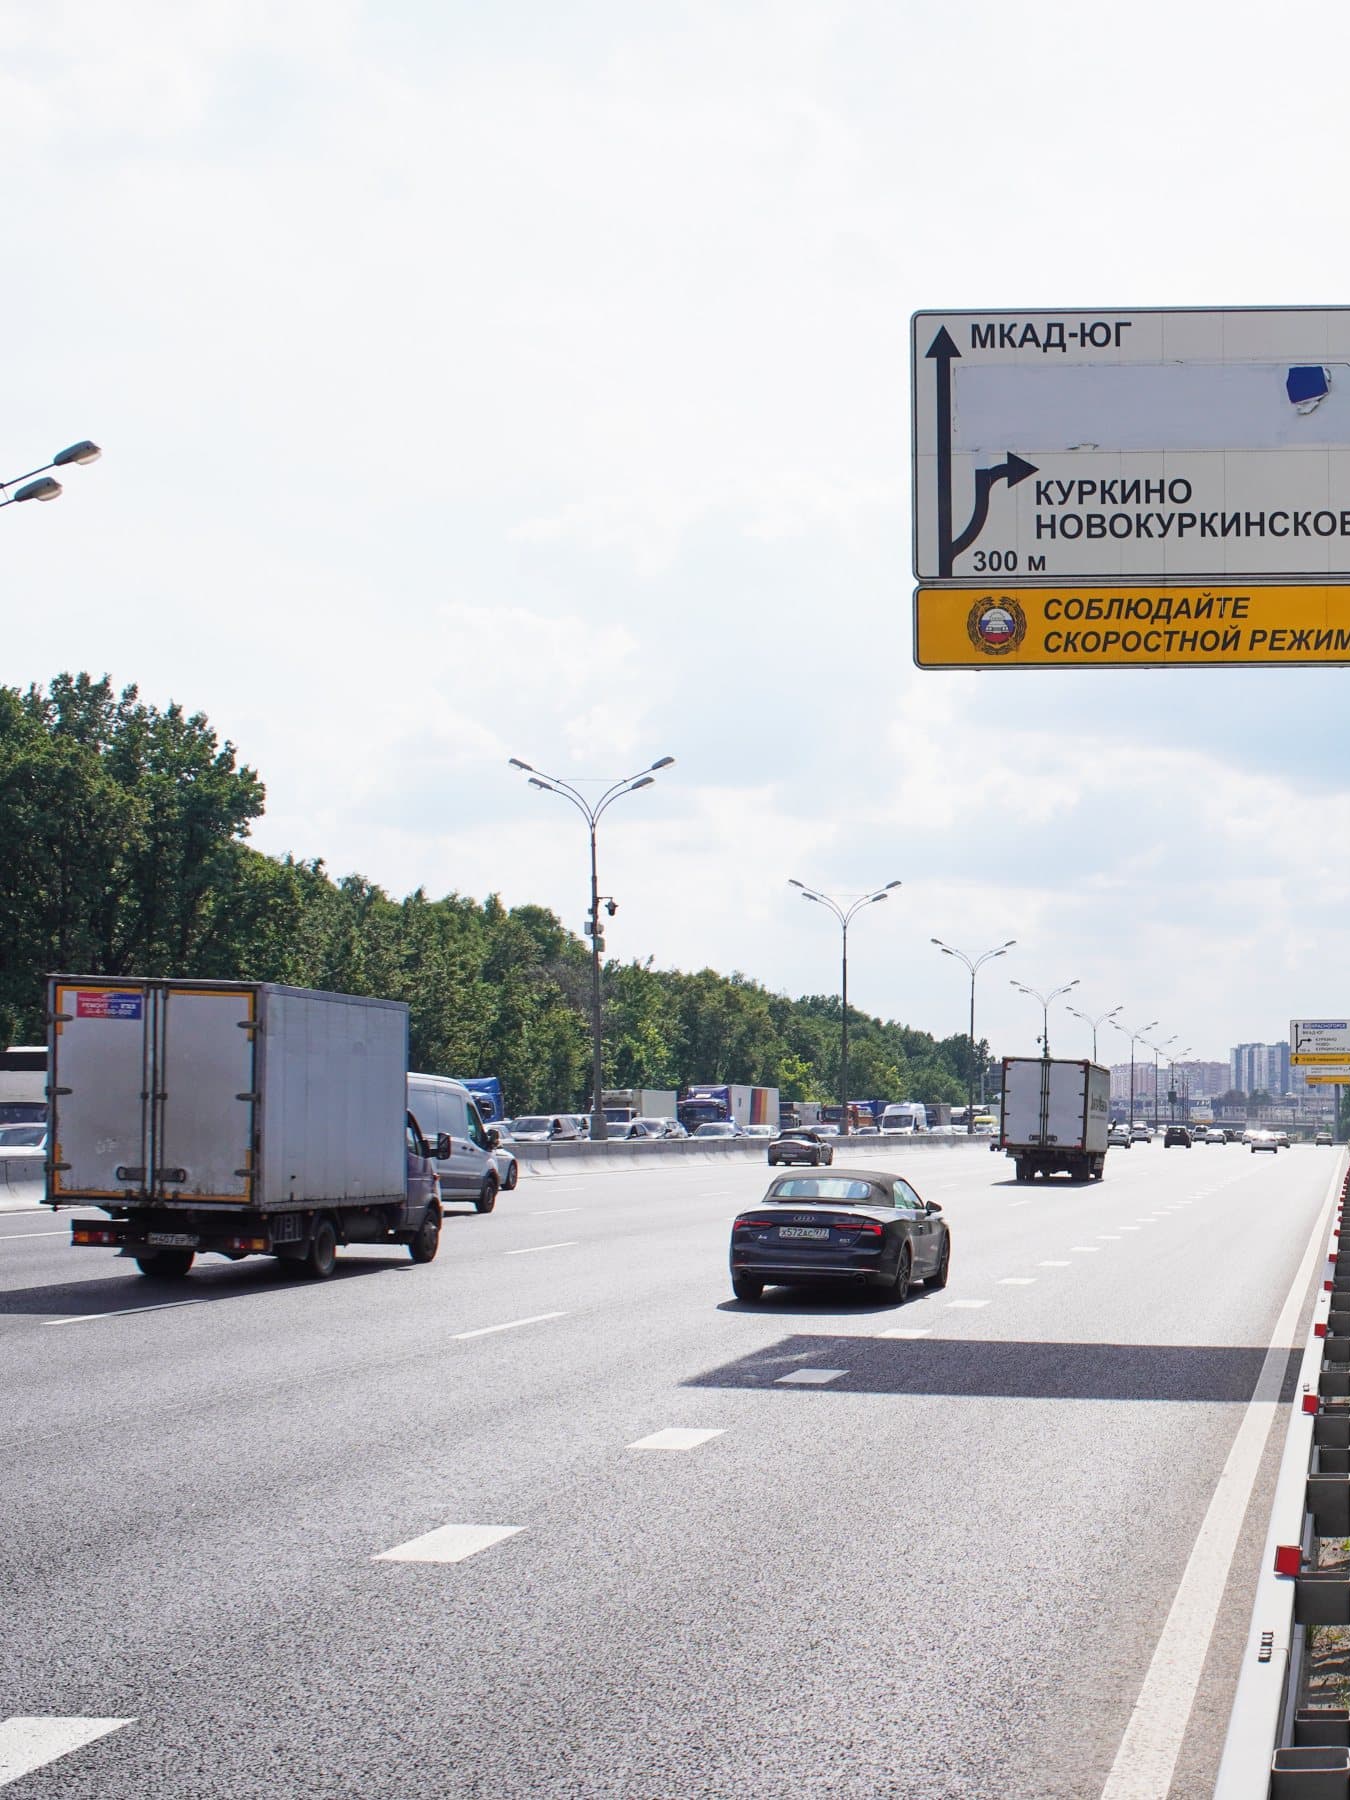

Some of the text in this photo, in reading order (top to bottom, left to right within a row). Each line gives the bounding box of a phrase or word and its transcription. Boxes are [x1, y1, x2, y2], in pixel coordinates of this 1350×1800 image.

[971, 321, 1132, 353] МКАД-ЮГ
[1034, 478, 1193, 507] КУРКИНО
[972, 550, 1019, 573] 300
[1043, 592, 1251, 623] СОБЛЮДАЙТЕ
[1043, 623, 1244, 654] СКОРОСТНОЙ
